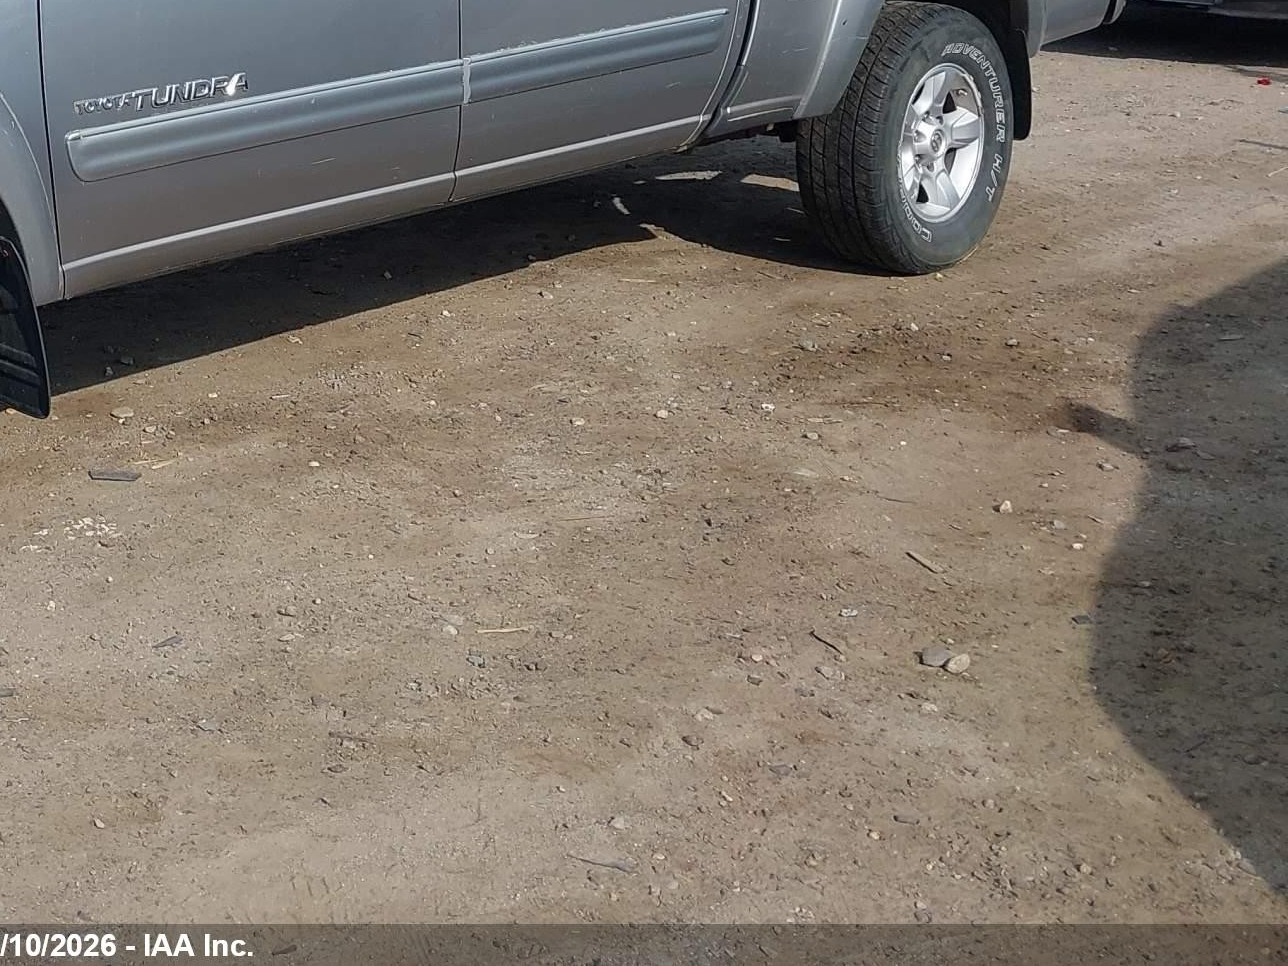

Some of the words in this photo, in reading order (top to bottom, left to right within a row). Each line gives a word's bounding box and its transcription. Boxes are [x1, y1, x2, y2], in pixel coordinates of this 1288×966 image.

[73, 92, 132, 115] TOYOTA
[131, 72, 249, 112] TUNDRA
[941, 42, 1006, 143] ADVENTURER
[985, 153, 1004, 202] H/T
